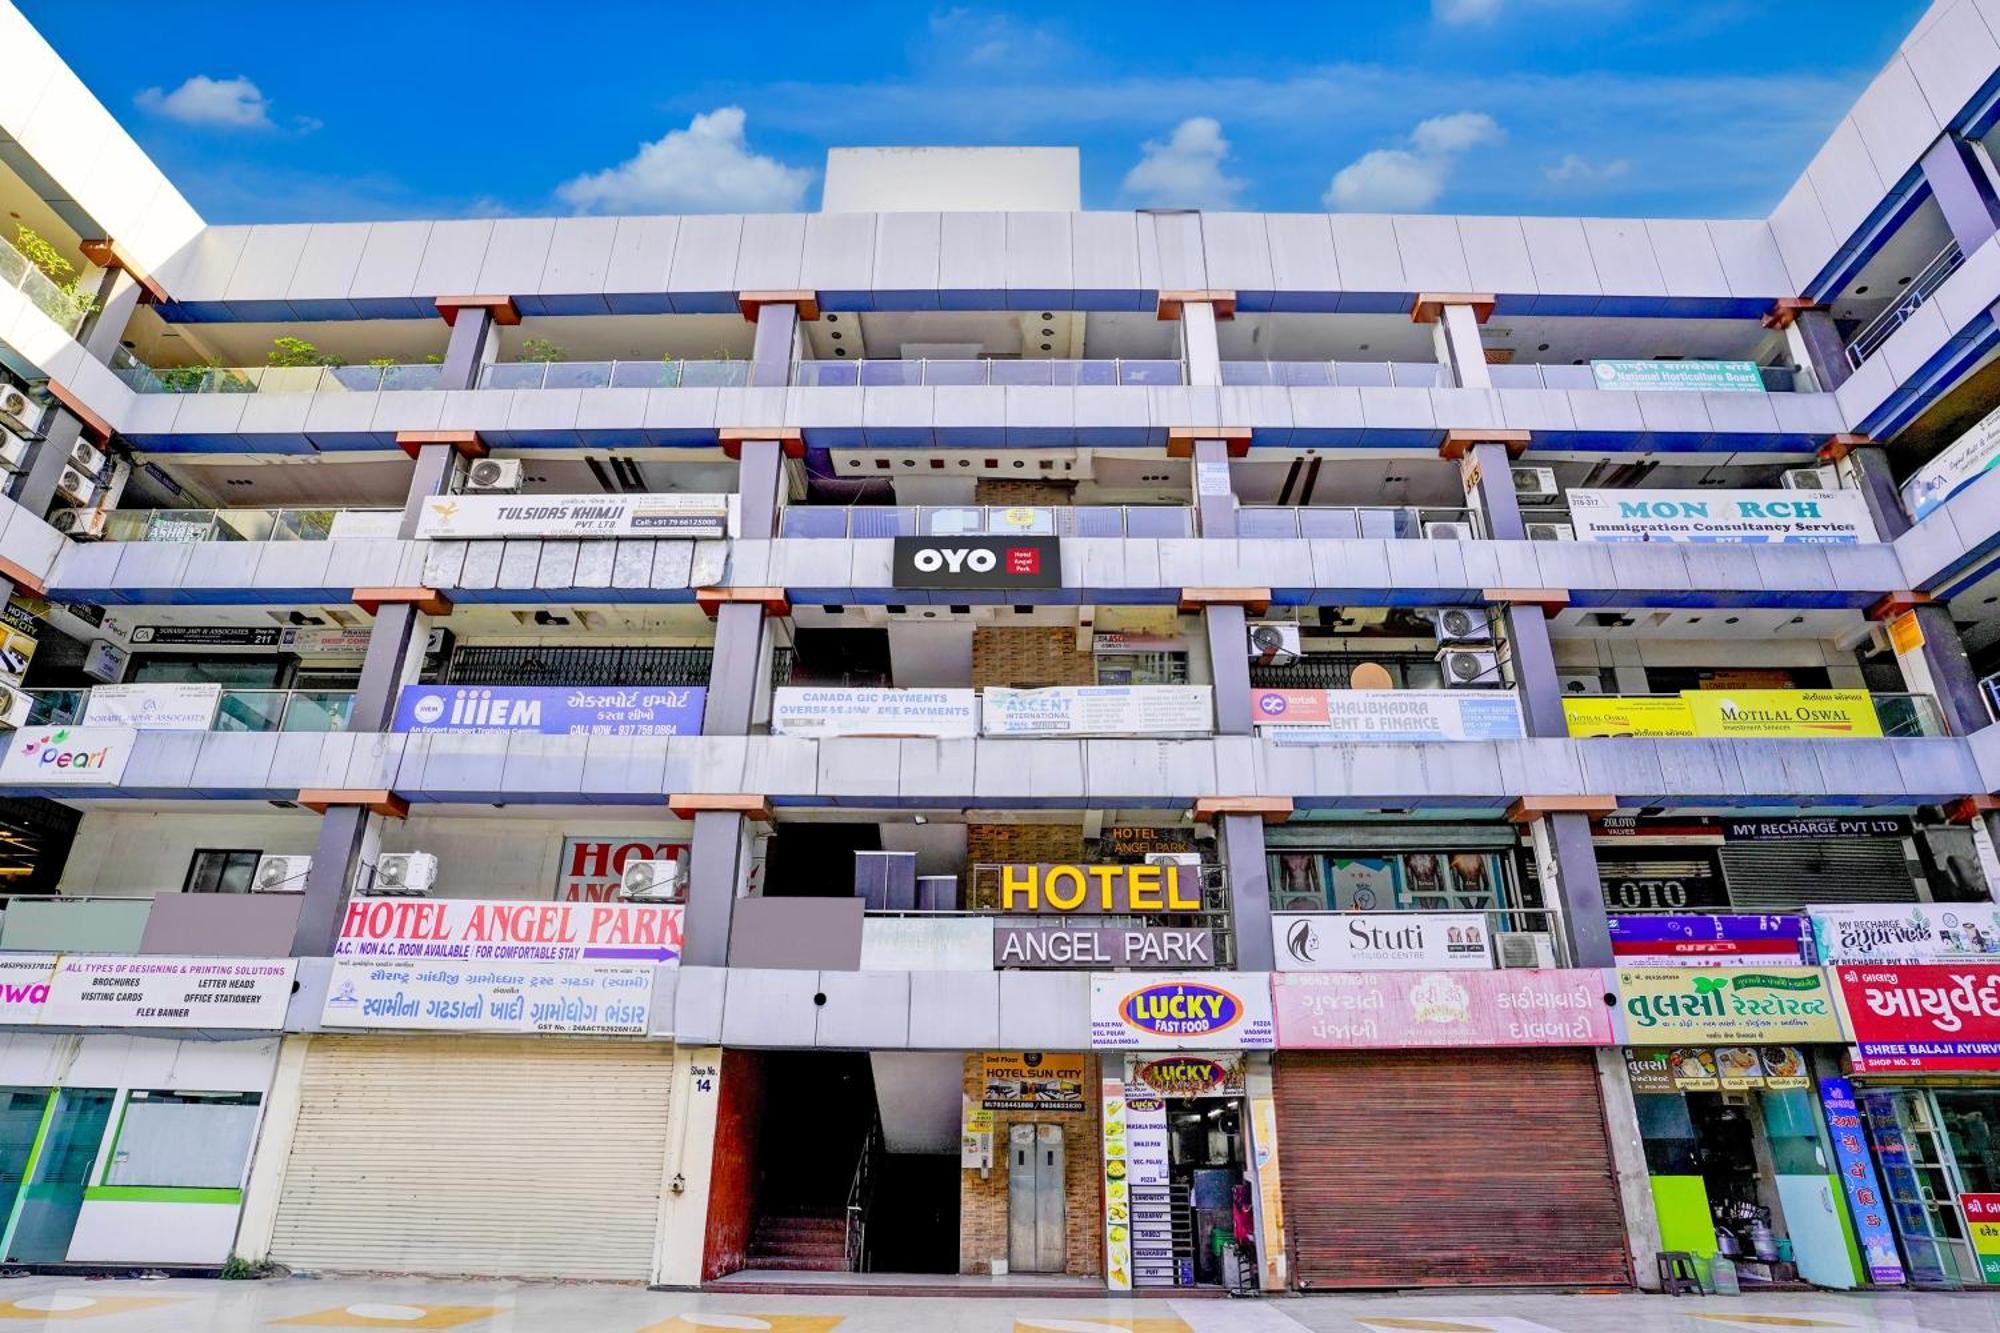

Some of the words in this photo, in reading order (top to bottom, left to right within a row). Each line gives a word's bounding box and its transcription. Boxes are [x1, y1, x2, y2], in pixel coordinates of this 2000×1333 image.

[1616, 371, 1660, 381] National
[1663, 371, 1724, 382] Horticulture
[1726, 372, 1757, 382] Board
[497, 506, 568, 520] TULSIDAS
[571, 506, 625, 520] KHIMJI
[575, 521, 595, 529] PVT.
[597, 521, 617, 529] LTD.
[1589, 522, 1689, 533] Immigration
[1693, 522, 1791, 533] Consultancy
[914, 549, 997, 573] OYO
[7, 606, 36, 624] HOTEL
[255, 634, 272, 643] 211
[802, 693, 853, 702] CANADA
[856, 694, 878, 702] GIC
[881, 694, 948, 703] PAYMENTS
[1006, 698, 1071, 711] ASCENT
[903, 707, 970, 716] PAYMENTS
[1721, 707, 1792, 722] MOTILAL
[1796, 707, 1850, 721] OSWAL
[1379, 716, 1440, 730] FINANCE
[39, 744, 109, 769] pearl
[1603, 818, 1636, 827] ZOLOTO
[1733, 824, 1757, 835] MY
[1760, 822, 1837, 834] RECHARGE
[1841, 821, 1868, 832] PVT
[1871, 821, 1899, 832] LTD
[1113, 828, 1158, 839] HOTEL
[1607, 828, 1635, 836] VALVES
[1114, 842, 1151, 853] ANGEL
[1155, 842, 1187, 852] PARK
[1001, 864, 1201, 911] HOTEL
[341, 902, 452, 941] HOTEL
[463, 902, 577, 944] ANGEL
[587, 907, 684, 945] PARK
[1839, 920, 1852, 929] MY
[1853, 920, 1901, 929] RECHARGE
[1349, 919, 1424, 950] Stuti
[335, 943, 352, 955] A.C.
[360, 944, 378, 956] NON
[379, 944, 396, 956] A.C.
[397, 944, 423, 957] ROOM
[424, 945, 469, 958] AVAILABLE
[475, 946, 492, 958] FOR
[494, 946, 557, 959] COMFORTABLE
[558, 948, 580, 960] STAY
[1002, 931, 1111, 962] ANGEL
[1124, 931, 1208, 962] PARK
[66, 963, 83, 972] ALL
[83, 964, 113, 973] TYPES
[115, 964, 127, 973] OF
[129, 964, 179, 974] DESIGNING
[180, 965, 187, 974] &
[189, 965, 233, 975] PRINTING
[235, 966, 285, 976] SOLUTIONS
[92, 977, 141, 987] BROCHURES
[1844, 970, 1859, 983] શ્રી
[1862, 973, 1898, 984] બાલાજી
[198, 979, 227, 989] LETTER
[229, 980, 256, 989] HEADS
[81, 992, 115, 1001] VISITING
[116, 992, 143, 1002] CARDS
[184, 994, 213, 1003] OFFICE
[214, 994, 262, 1004] STATIONERY
[362, 992, 420, 1017] સ્વામીના
[426, 994, 484, 1019] ગઢડાનો
[490, 995, 525, 1021] ખાદી
[1136, 994, 1224, 1020] LUCKY
[1301, 990, 1385, 1017] ગુજરાતી
[136, 1008, 156, 1017] FLEX
[158, 1008, 189, 1018] BANNER
[1155, 1019, 1181, 1033] FAST
[1181, 1019, 1210, 1032] FOOD
[1865, 1044, 1907, 1055] SHREE
[1909, 1044, 1952, 1054] BALAJI
[1868, 1058, 1892, 1066] SHOP
[1893, 1058, 1909, 1066] NO.
[1911, 1058, 1921, 1066] 20
[691, 1066, 706, 1077] Shop
[707, 1066, 719, 1076] No.
[987, 1069, 1027, 1078] HOTEL
[1027, 1069, 1053, 1078] SUN
[1056, 1069, 1081, 1078] CITY
[1152, 1064, 1212, 1081] LUCKY
[696, 1079, 711, 1092] 14
[1131, 1100, 1159, 1108] LUCKY
